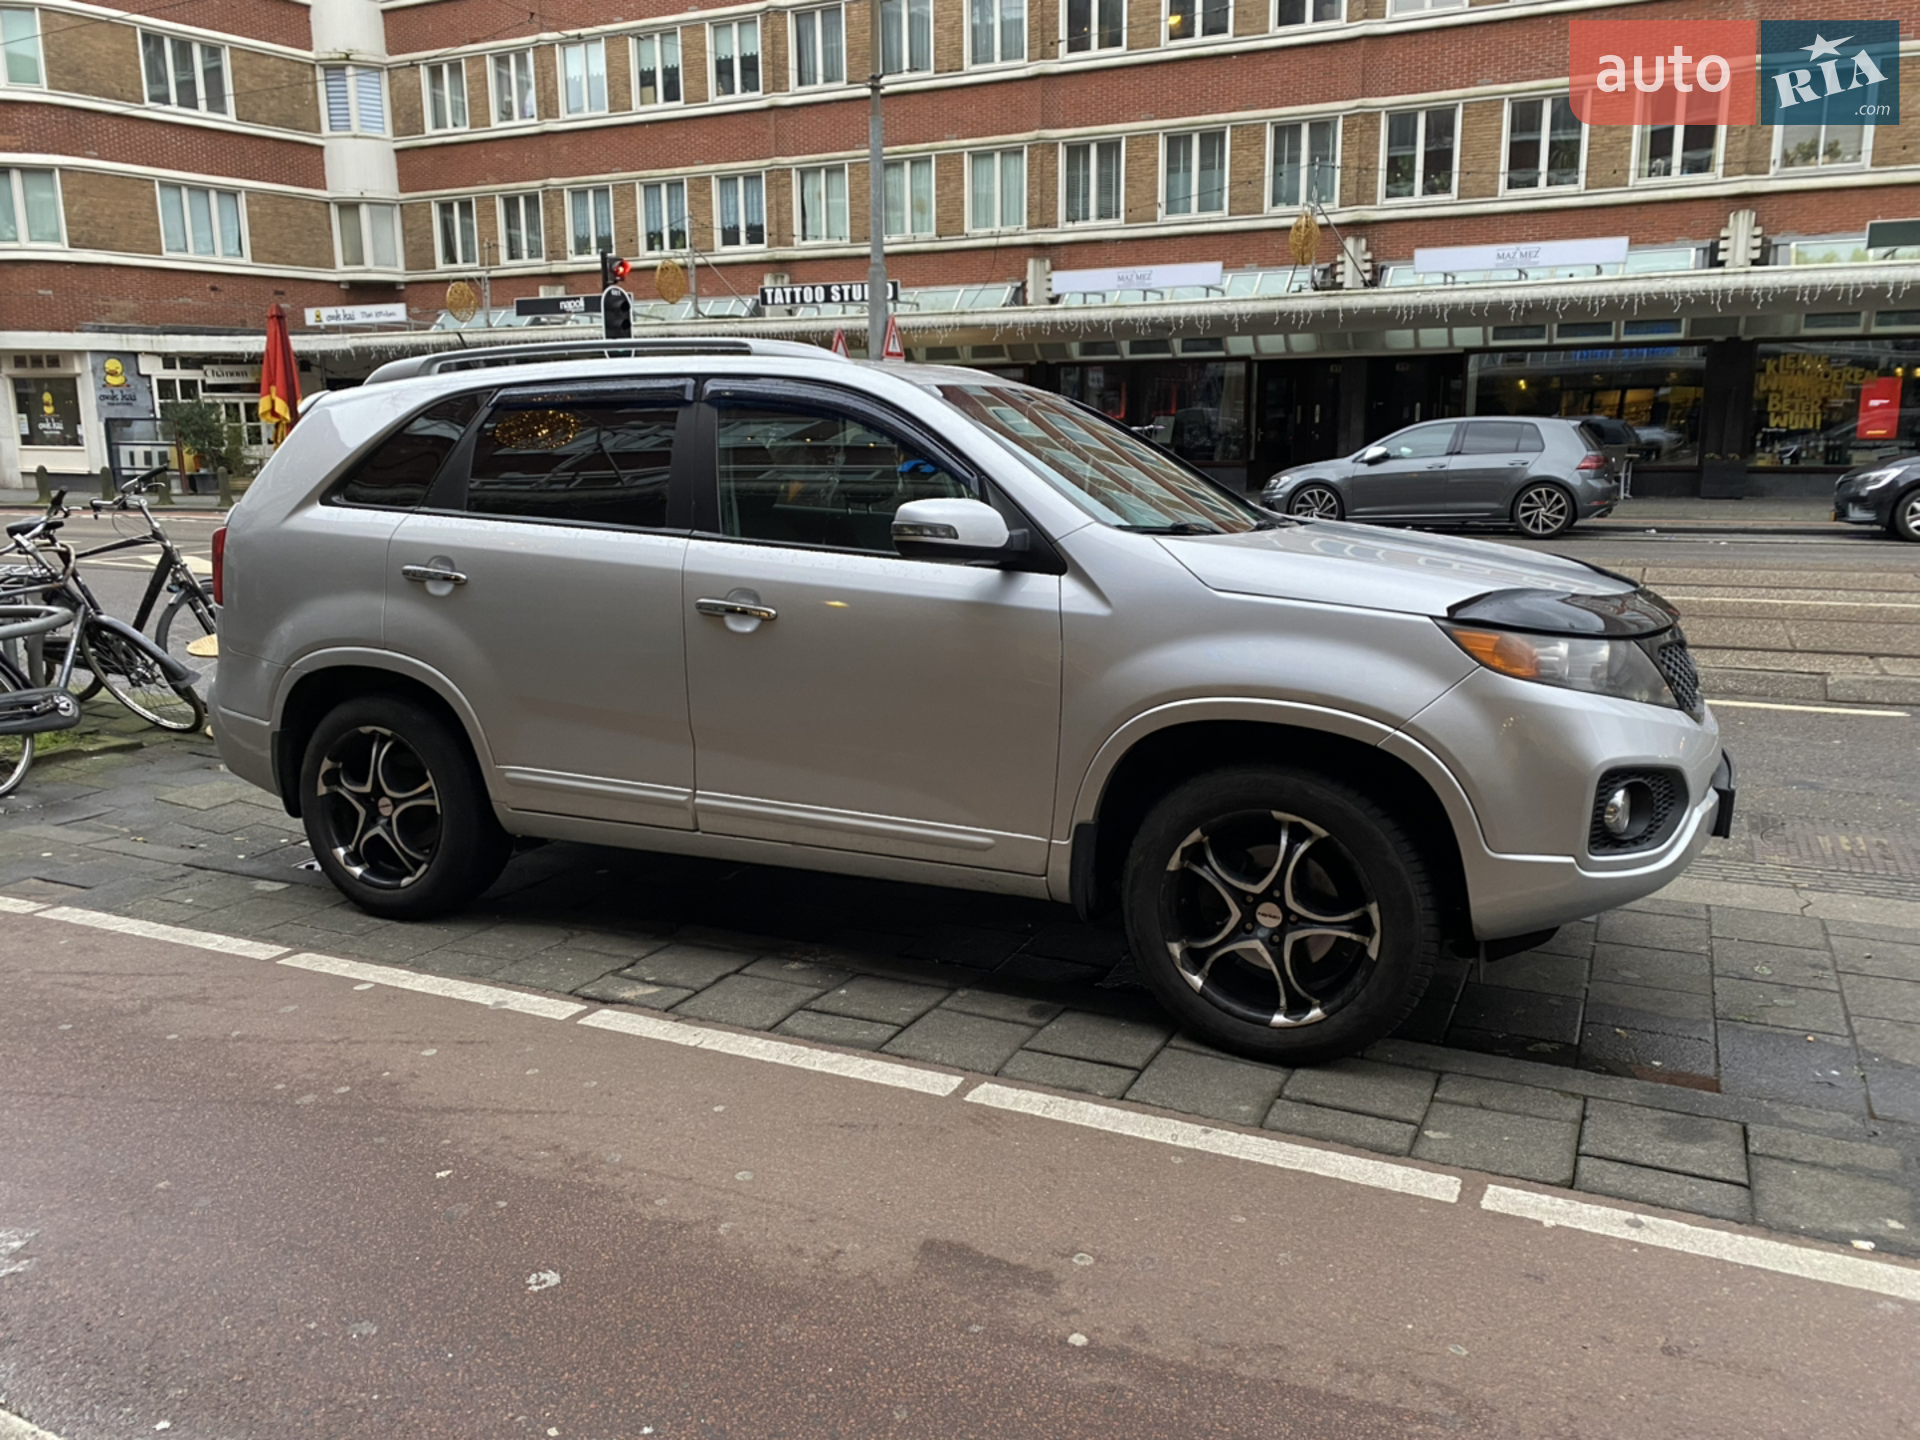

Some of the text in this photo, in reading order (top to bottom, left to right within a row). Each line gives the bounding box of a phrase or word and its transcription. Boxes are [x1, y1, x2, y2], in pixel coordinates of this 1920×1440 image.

[1496, 249, 1540, 260] MAZ MEZ
[764, 286, 825, 305] TATTOO
[1767, 393, 1823, 412] BETER
